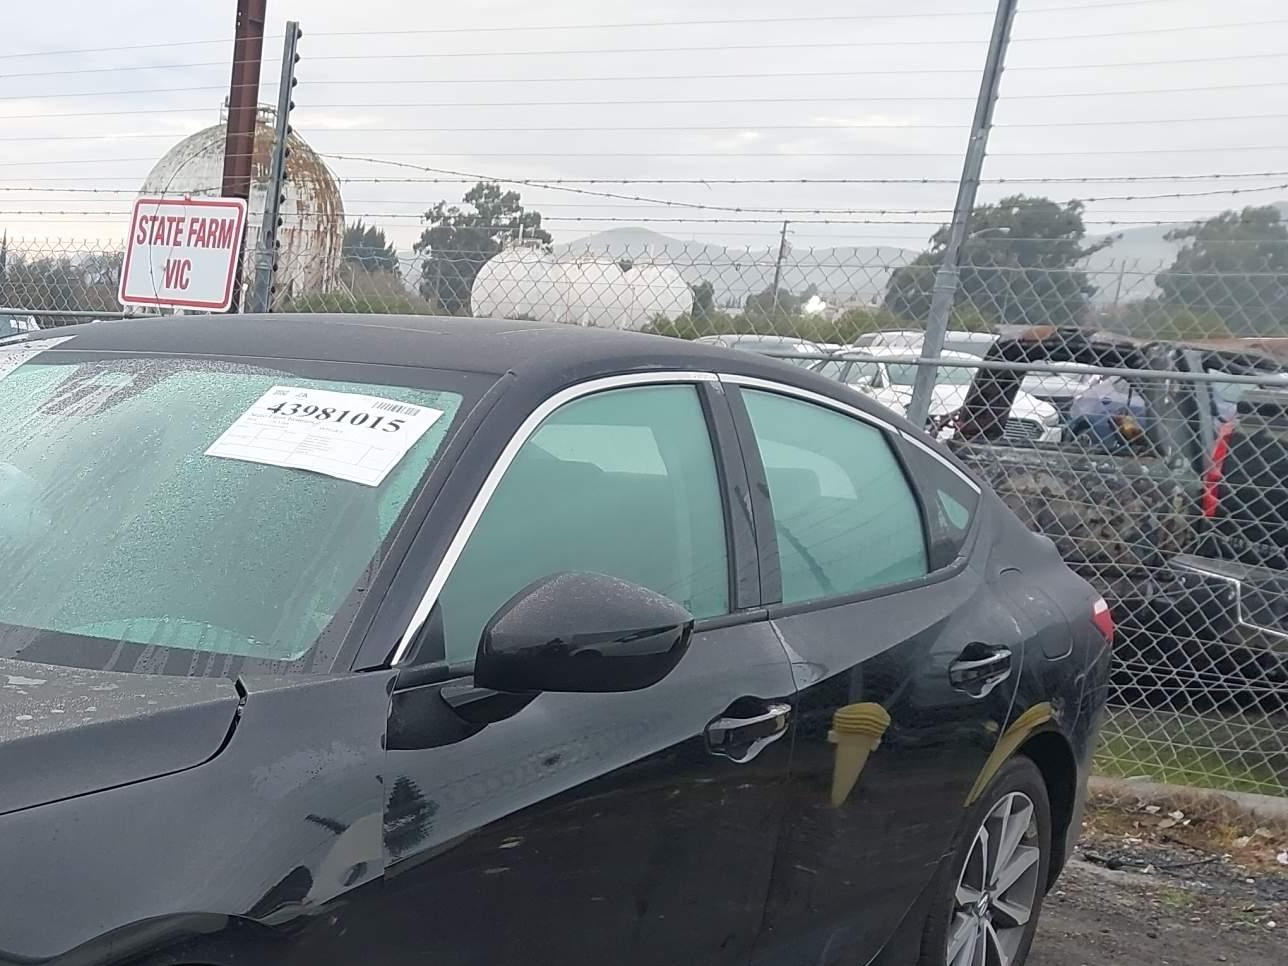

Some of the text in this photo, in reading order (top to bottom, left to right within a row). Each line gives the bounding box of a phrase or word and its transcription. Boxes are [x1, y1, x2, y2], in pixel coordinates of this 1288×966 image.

[136, 214, 235, 249] STATE FARM
[164, 258, 192, 290] VIC
[266, 401, 406, 433] 43981015
